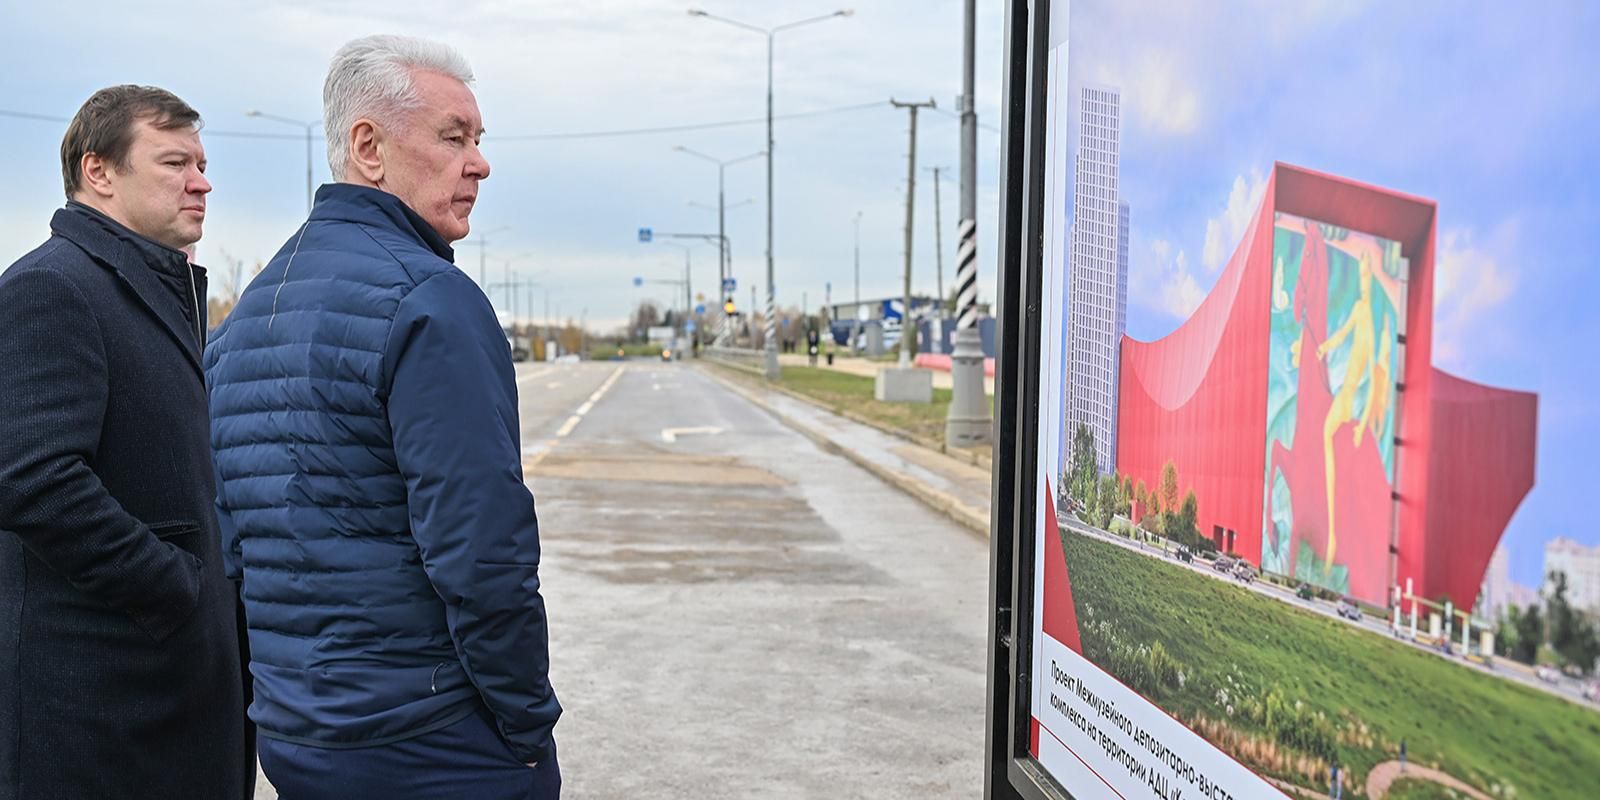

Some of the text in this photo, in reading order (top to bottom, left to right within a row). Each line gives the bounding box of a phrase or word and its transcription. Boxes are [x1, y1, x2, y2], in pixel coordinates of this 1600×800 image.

[1051, 660, 1075, 692] Проект
[1075, 678, 1132, 736] Межмузейного
[1050, 691, 1086, 732] комплекса
[1086, 721, 1097, 741] на
[1098, 730, 1146, 782] территории
[1148, 767, 1168, 800] АДЦ
